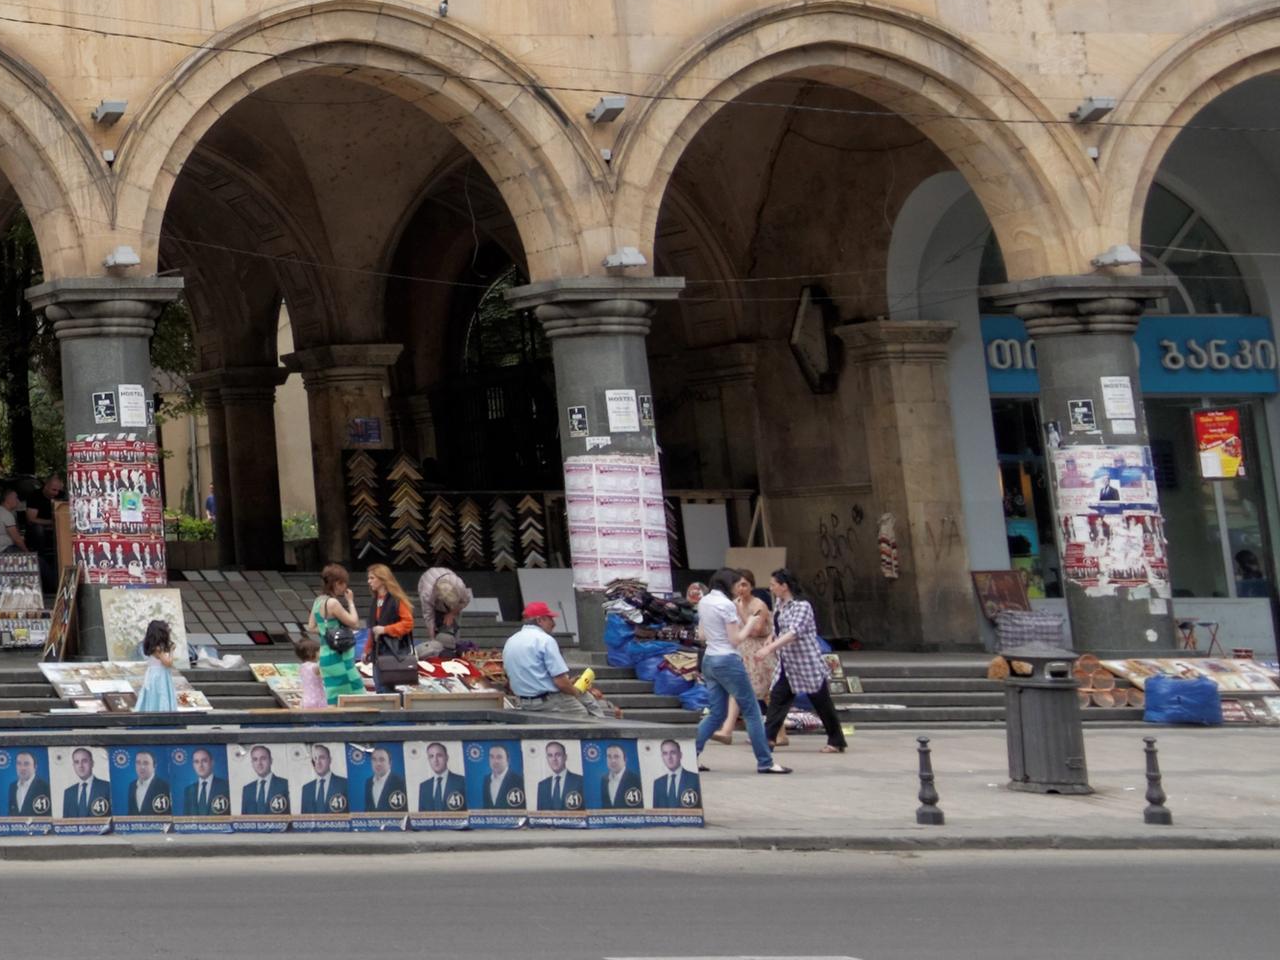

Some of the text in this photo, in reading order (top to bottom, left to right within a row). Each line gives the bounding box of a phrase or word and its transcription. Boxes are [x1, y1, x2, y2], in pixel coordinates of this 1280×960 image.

[1160, 339, 1277, 370] ბანკი
[390, 795, 403, 805] 41
[449, 796, 462, 806] 41
[509, 792, 522, 802] 41
[567, 795, 580, 805] 41
[626, 792, 640, 801] 41
[682, 793, 696, 803] 41
[34, 799, 48, 809] 41
[93, 801, 106, 812] 41
[154, 798, 167, 809] 41
[213, 799, 226, 809] 41
[271, 799, 284, 809] 41
[331, 798, 344, 808] 41
